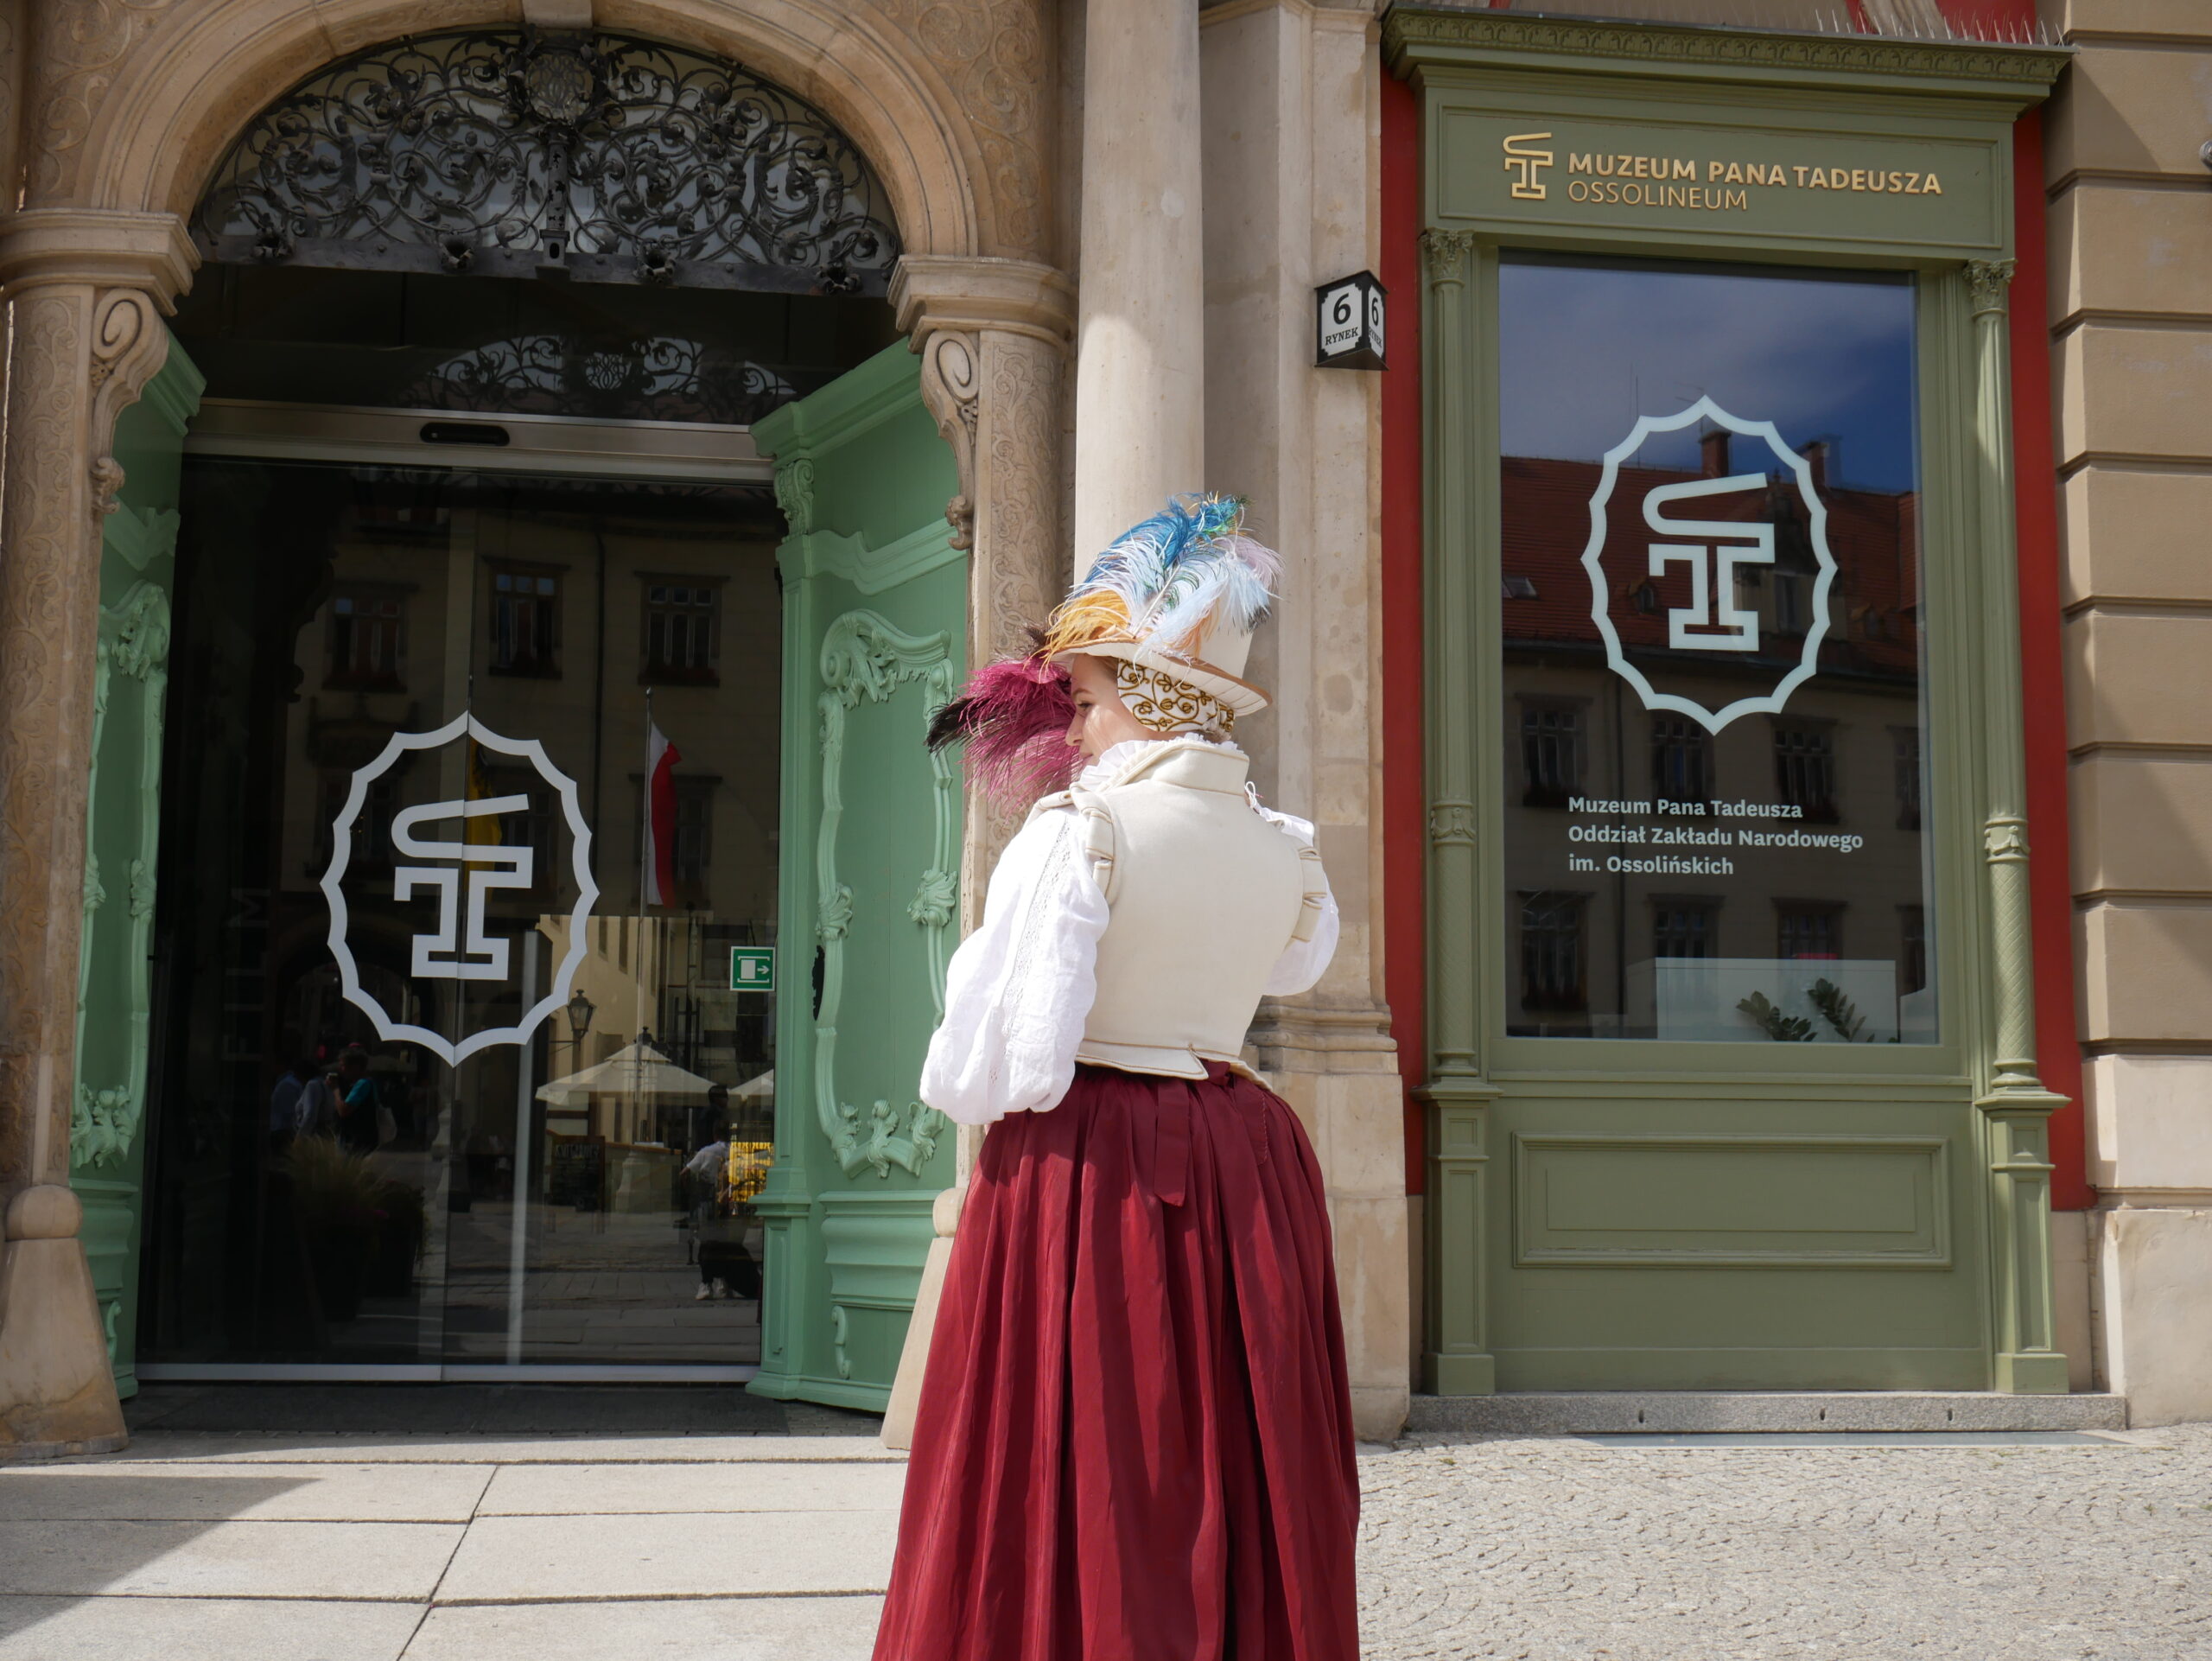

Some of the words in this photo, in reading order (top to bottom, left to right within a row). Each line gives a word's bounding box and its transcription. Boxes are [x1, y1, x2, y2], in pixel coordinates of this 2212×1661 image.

[1568, 153, 1696, 181] MUZEUM
[1707, 161, 1787, 186] PANA
[1793, 165, 1942, 194] TADEUSZA
[1568, 181, 1747, 210] OSSOLINEUM
[1333, 293, 1351, 324] 6
[1371, 296, 1378, 327] 6
[1325, 327, 1358, 346] RYNEK
[1568, 797, 1651, 814] Muzeum
[1657, 799, 1706, 816] Pana
[1711, 799, 1803, 818] Tadeusza
[1568, 825, 1646, 843] Oddział
[1651, 827, 1732, 846] Zakładu
[1738, 830, 1863, 853] Narodowego
[1568, 854, 1600, 872] im.
[1606, 856, 1734, 875] Ossolińskich
